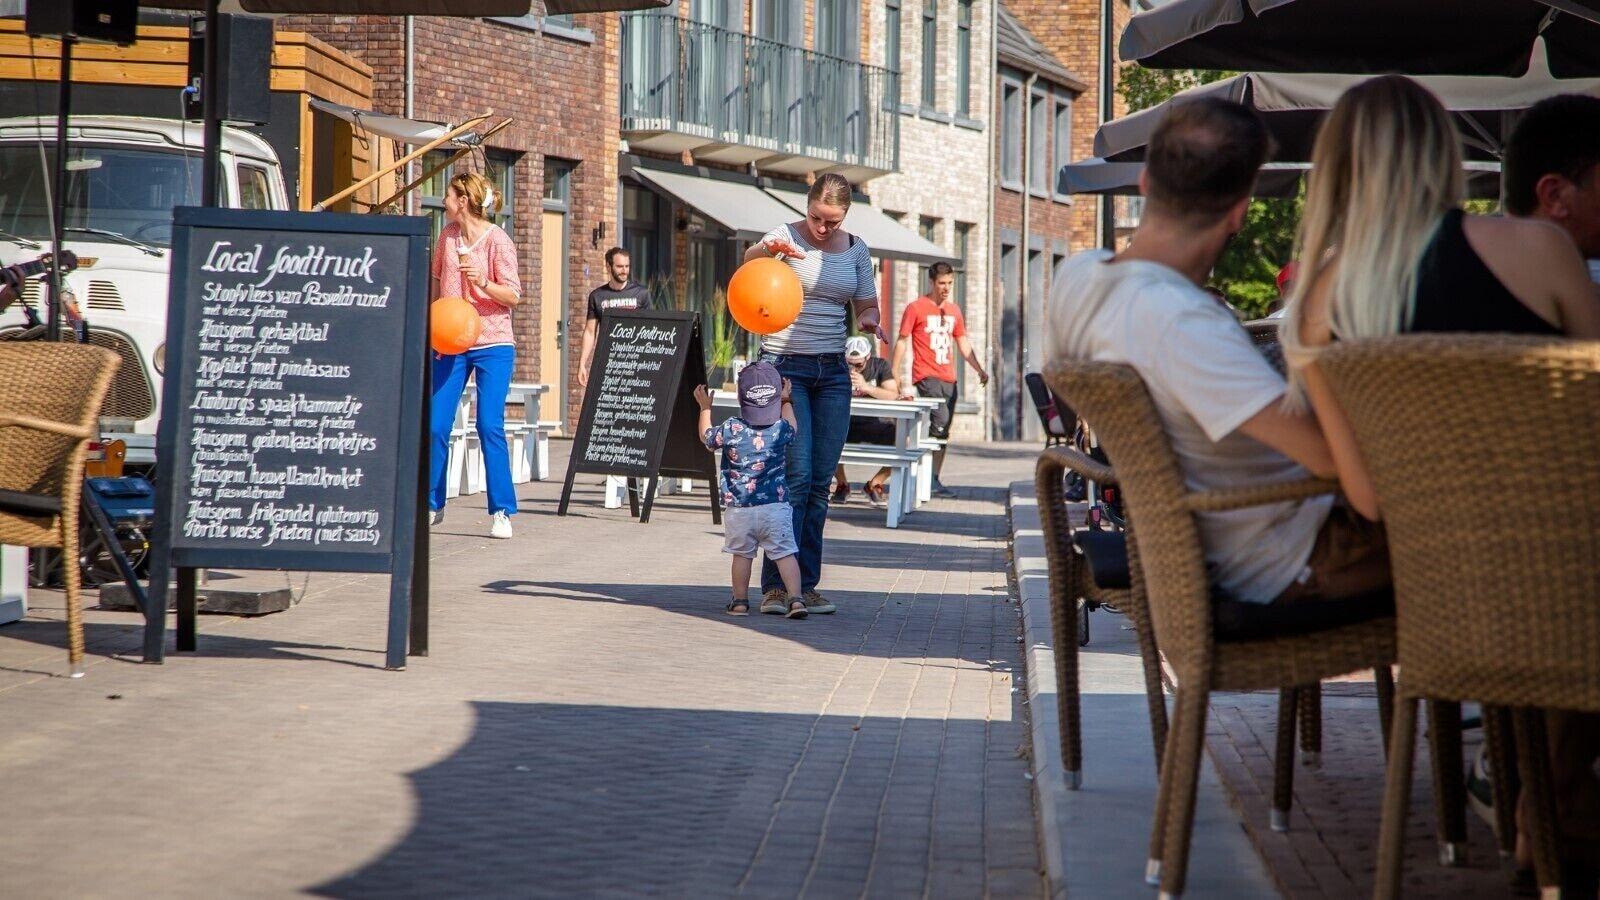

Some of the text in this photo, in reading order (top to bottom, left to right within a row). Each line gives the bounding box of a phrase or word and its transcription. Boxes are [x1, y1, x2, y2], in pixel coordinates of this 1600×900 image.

[201, 241, 378, 288] Local foodtruck
[275, 290, 302, 305] van
[203, 304, 288, 324] met verse frieten
[258, 321, 330, 344] gehaktbal
[609, 323, 636, 339] Local
[199, 339, 290, 361] met verse frieten
[250, 357, 278, 375] met
[276, 358, 350, 380] pindasaus
[195, 376, 283, 396] met verse frieten
[189, 390, 363, 418] Limburgs spaakhammetje
[293, 418, 318, 428] verse
[318, 415, 356, 433] frieten
[252, 430, 377, 455] geitenkaaskroketjes
[249, 463, 364, 489] heuvellandkroket
[191, 485, 285, 501] van pasveldrund
[247, 501, 315, 526] frikandel
[183, 519, 381, 547] Portie verse frieten (met saus)
